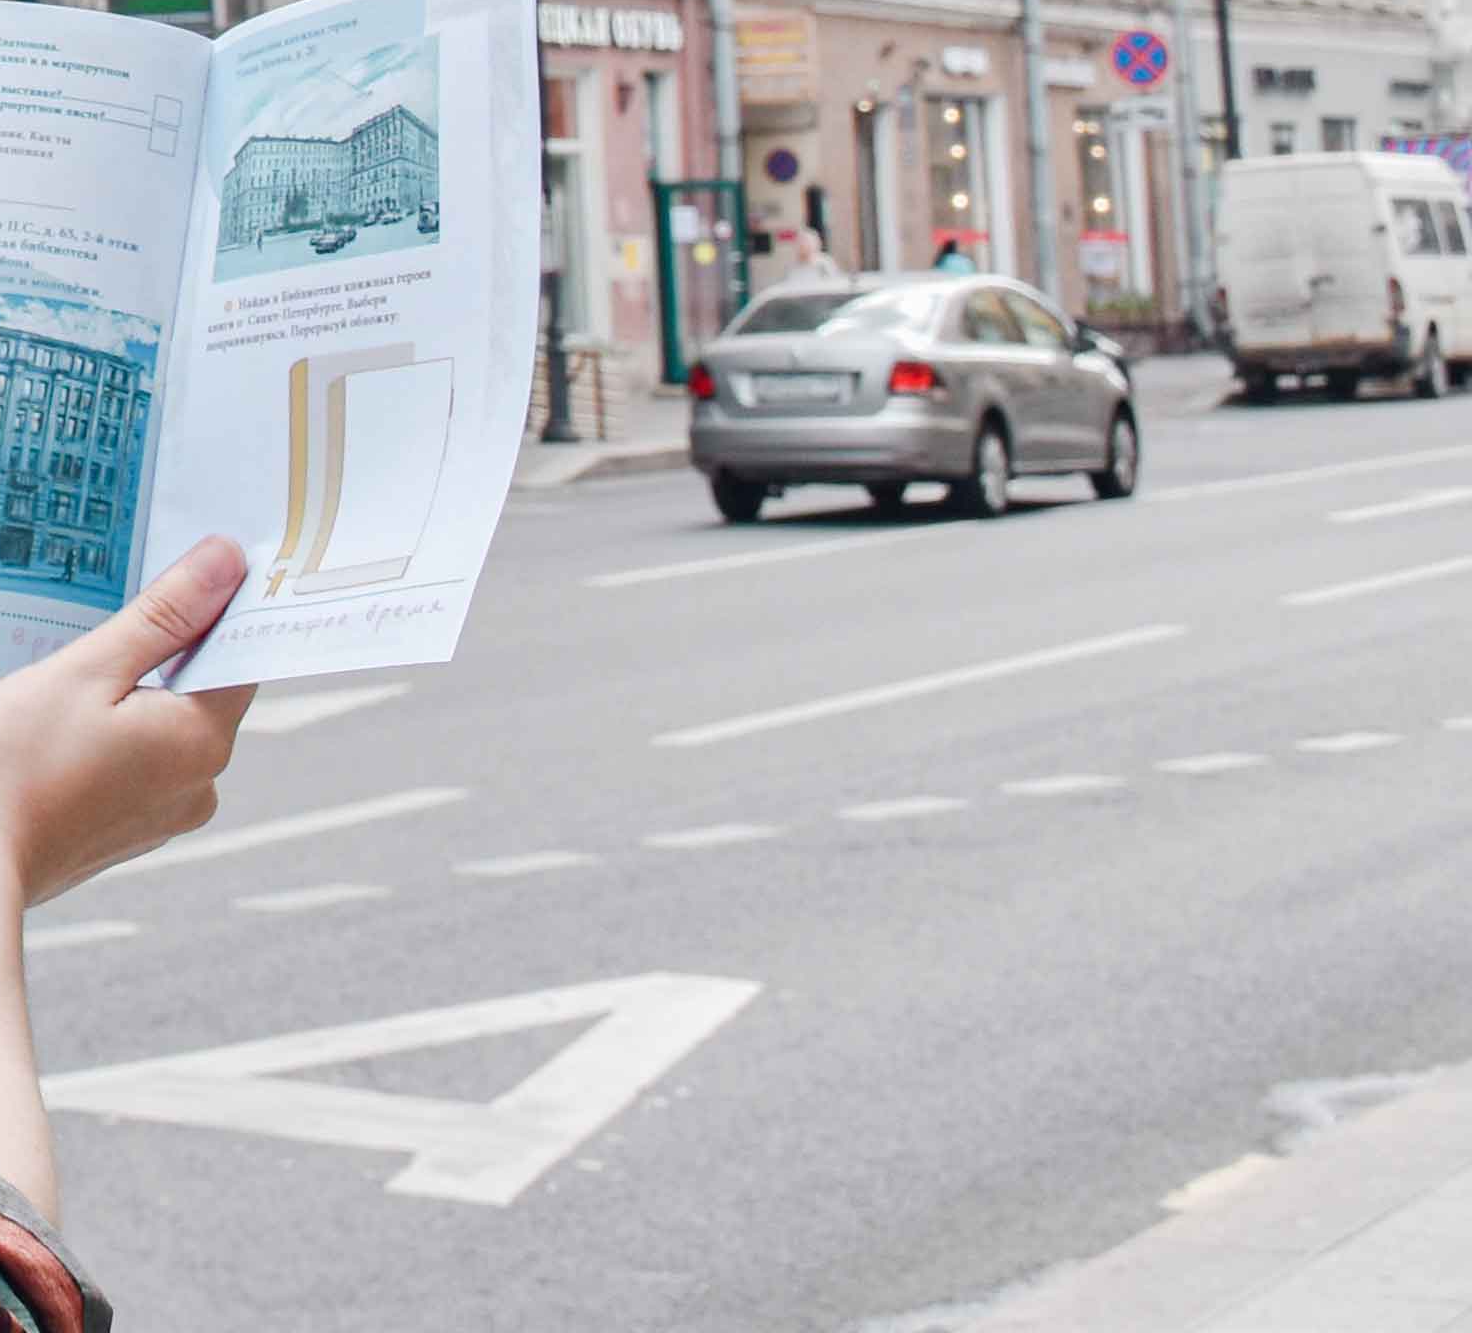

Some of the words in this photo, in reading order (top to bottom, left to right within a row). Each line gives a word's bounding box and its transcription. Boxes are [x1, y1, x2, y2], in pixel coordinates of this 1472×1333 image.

[51, 59, 130, 80] маршрутном
[29, 131, 51, 143] Как
[55, 136, 72, 146] ты
[20, 239, 99, 262] библиотека
[238, 294, 271, 311] Найди
[281, 284, 342, 303] Библиотеке
[344, 276, 395, 293] книжных
[396, 268, 433, 286] героев
